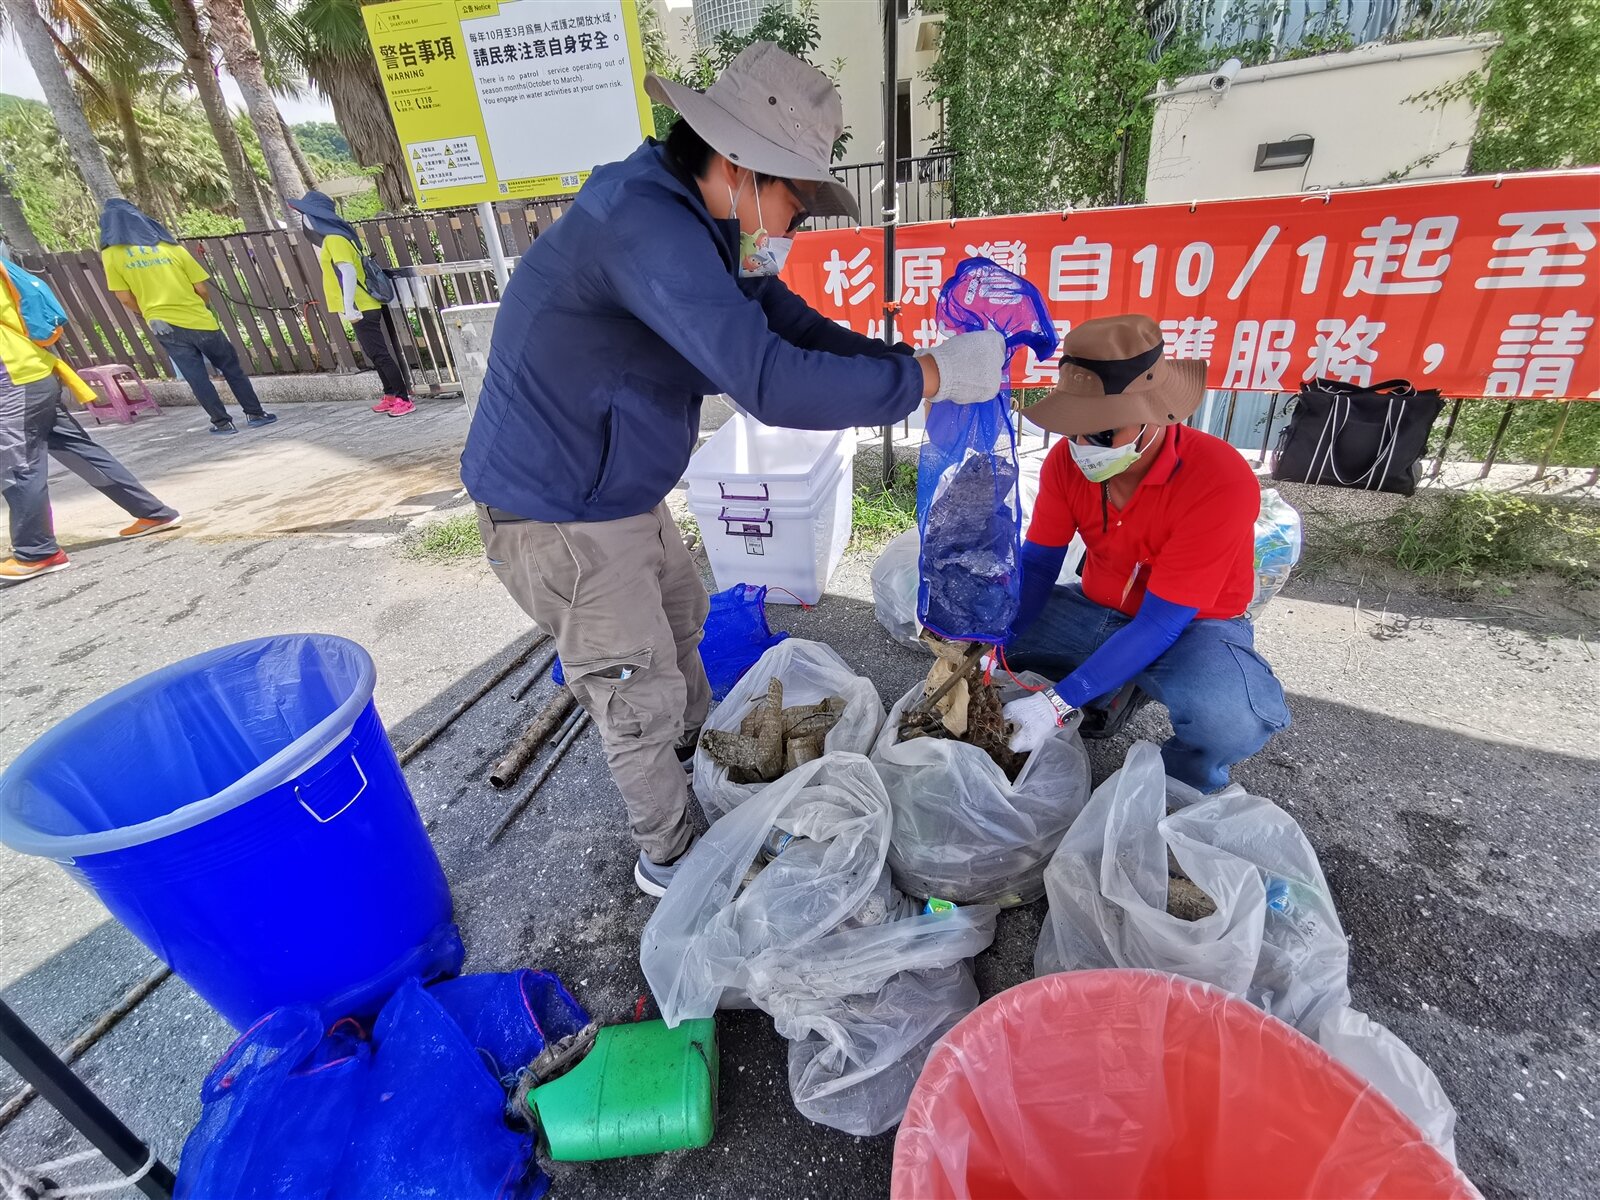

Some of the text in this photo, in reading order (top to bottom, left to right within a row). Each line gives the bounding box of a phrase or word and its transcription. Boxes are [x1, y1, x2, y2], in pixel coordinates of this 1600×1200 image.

[379, 36, 456, 70] 警告事項
[386, 69, 425, 82] WARNING
[479, 76, 496, 84] There
[519, 70, 539, 80] patrol
[547, 66, 569, 75] service
[572, 62, 602, 72] operating
[605, 59, 615, 67] out
[618, 57, 625, 65] of
[481, 86, 503, 95] season
[497, 95, 518, 104] engage
[526, 91, 543, 99] water
[544, 87, 572, 97] activities
[580, 84, 594, 93] your
[609, 80, 623, 88] risk.
[400, 96, 433, 107] 119 118
